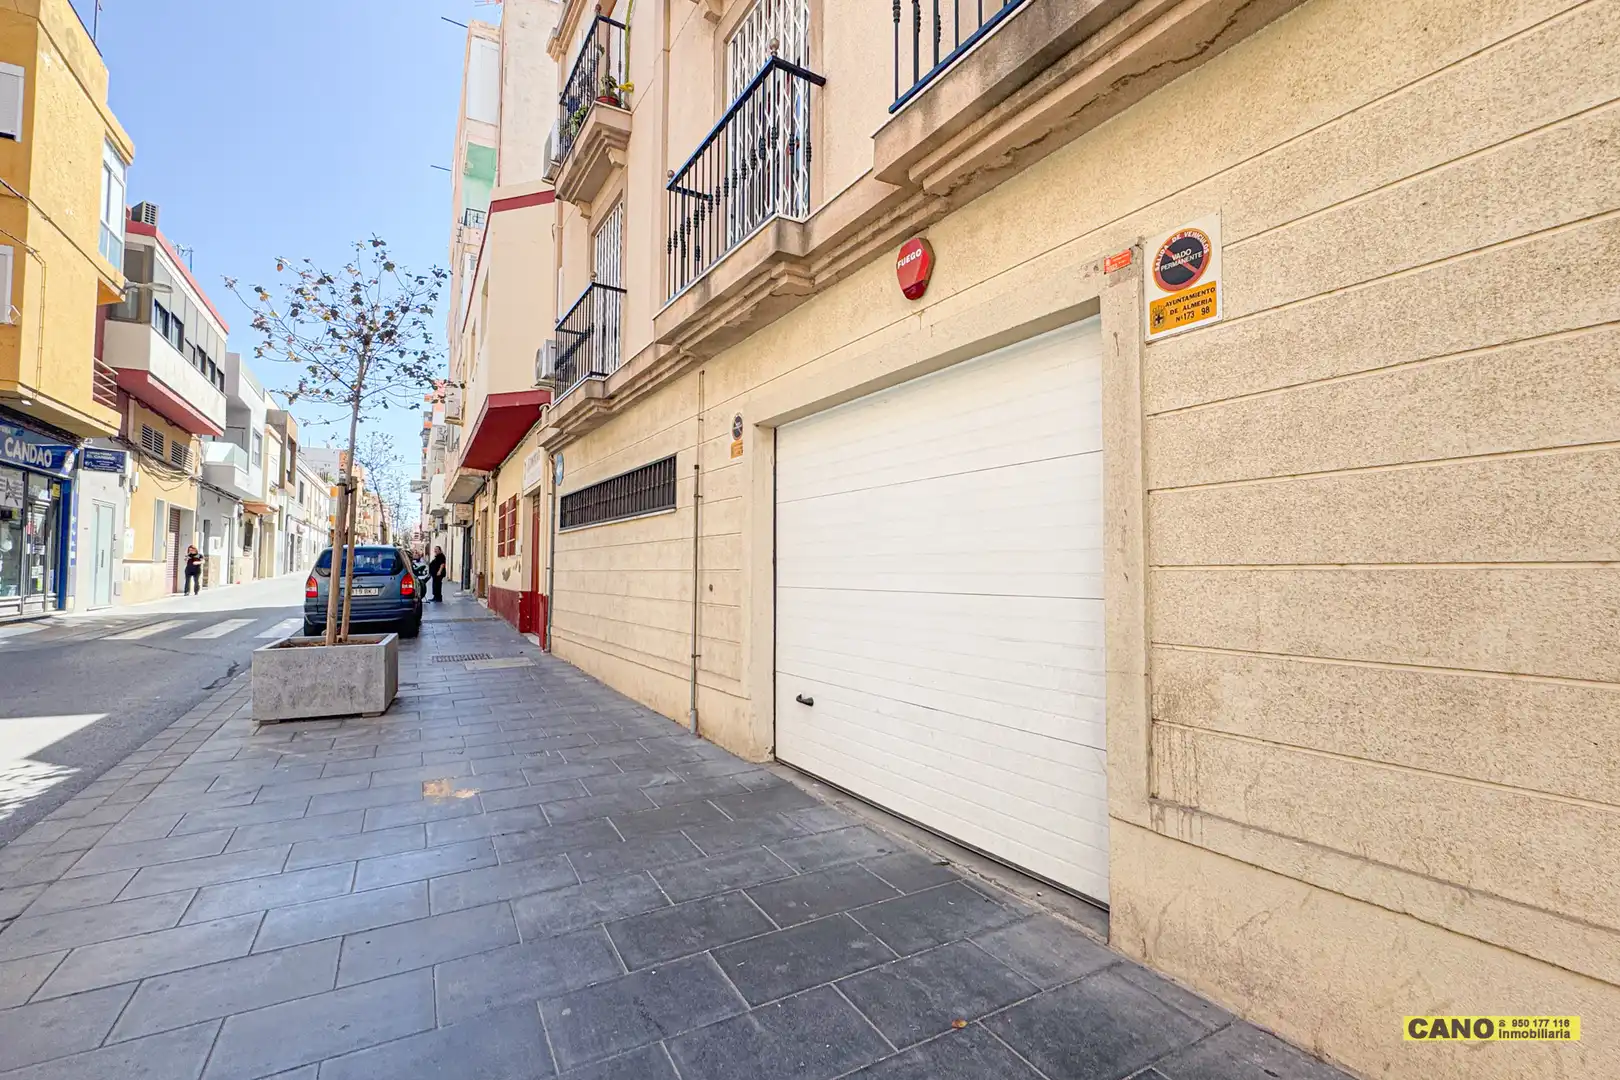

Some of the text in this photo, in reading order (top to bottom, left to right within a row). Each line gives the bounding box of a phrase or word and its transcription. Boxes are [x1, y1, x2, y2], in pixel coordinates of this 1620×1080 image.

[1172, 234, 1182, 242] DE
[1184, 231, 1209, 254] VEHICULOS
[897, 248, 922, 270] FUEGO
[1160, 250, 1203, 272] PERMANENTE
[1171, 248, 1192, 261] VADO
[1165, 287, 1216, 307] AYUNTAMIENTO
[1182, 297, 1213, 312] ALMERIA
[1200, 305, 1211, 316] 98
[5, 437, 52, 468] CANDAO
